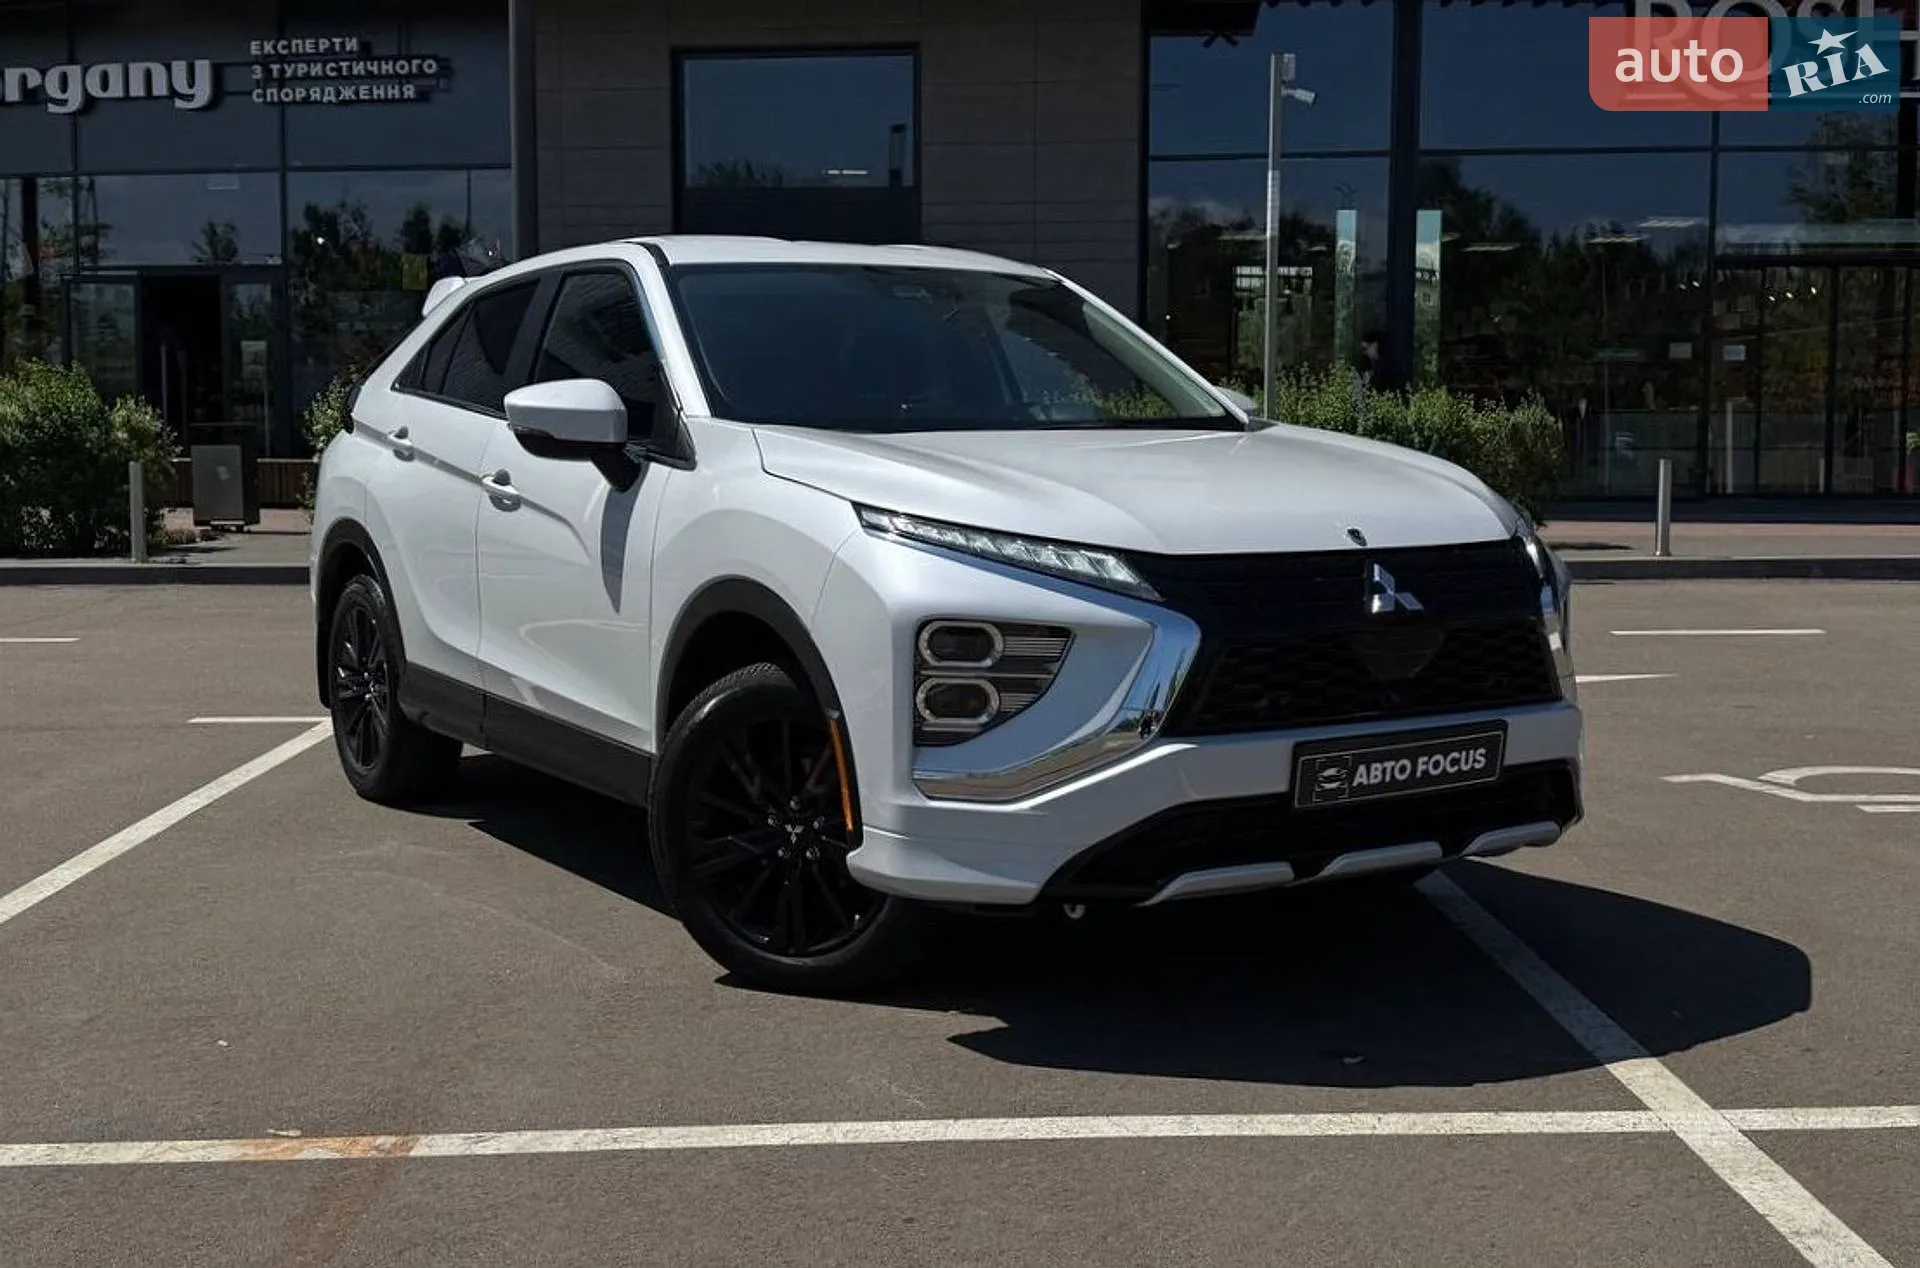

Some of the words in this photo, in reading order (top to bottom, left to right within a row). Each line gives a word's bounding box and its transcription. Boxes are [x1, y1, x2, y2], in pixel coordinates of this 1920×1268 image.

[250, 37, 358, 56] ЕКСПЕРТИ
[269, 59, 438, 79] ТУРИСТИЧНОГО
[0, 59, 213, 114] rgany
[251, 84, 416, 103] СПОРЯДЖЕННЯ
[1352, 758, 1412, 787] АВТО
[1415, 747, 1487, 778] FOCUS
